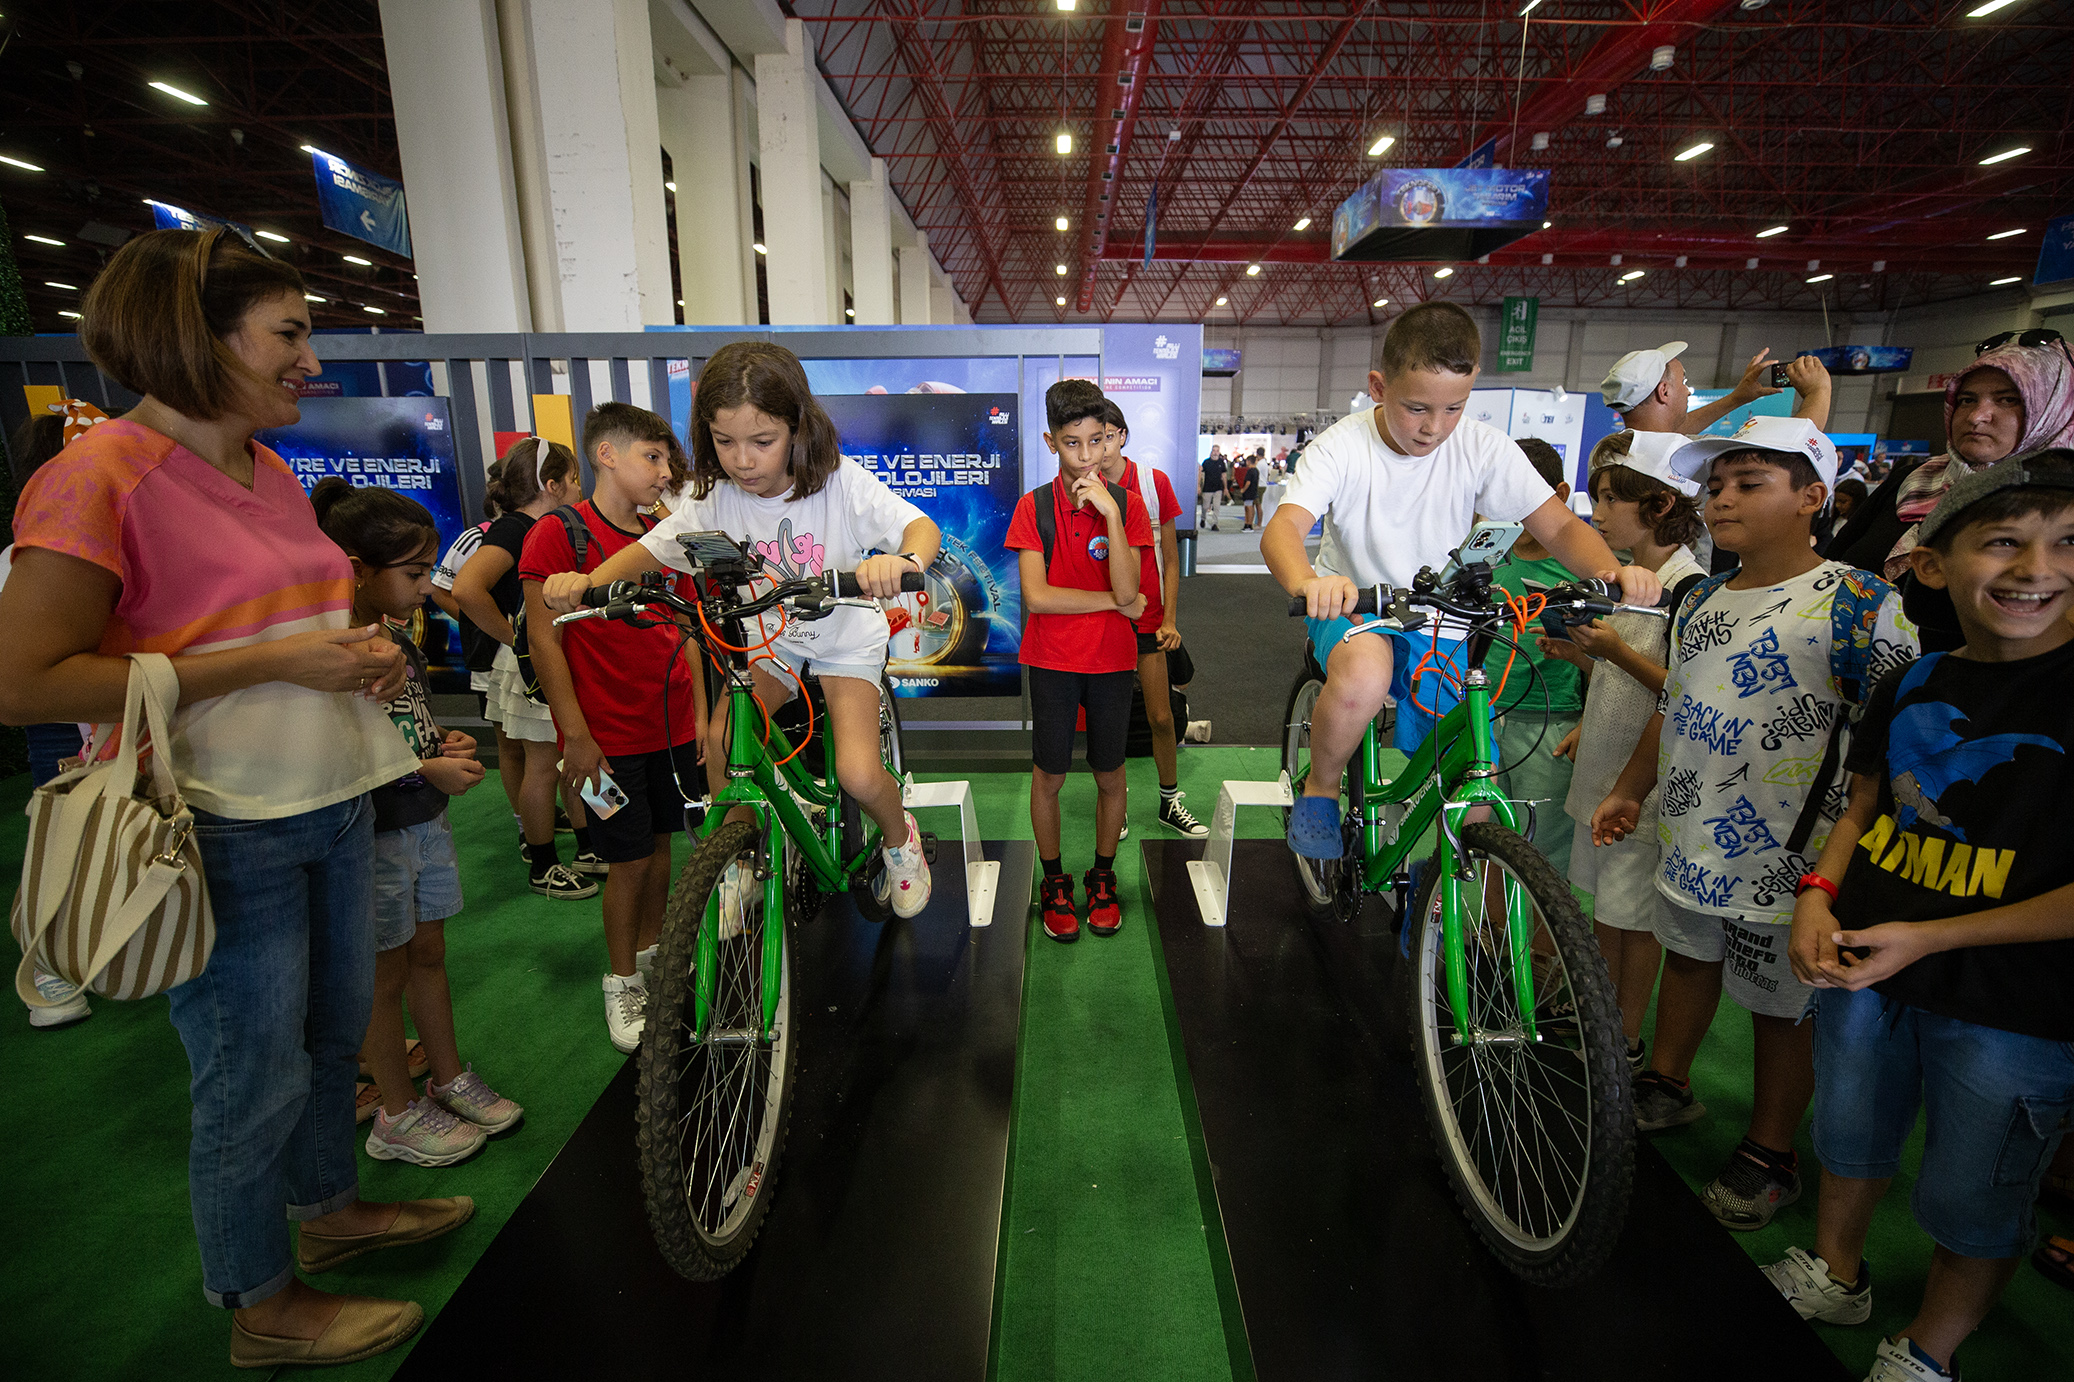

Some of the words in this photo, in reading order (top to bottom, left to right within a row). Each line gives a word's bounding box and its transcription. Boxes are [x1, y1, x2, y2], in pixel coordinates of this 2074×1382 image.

[1506, 357, 1525, 366] EXIT
[328, 458, 360, 472] VE
[882, 454, 916, 469] VE
[968, 550, 1002, 612] FESTIVAL
[902, 678, 939, 687] SANKO
[1794, 1252, 1814, 1271] LOTTO
[1888, 1350, 1926, 1373] LOTTO
